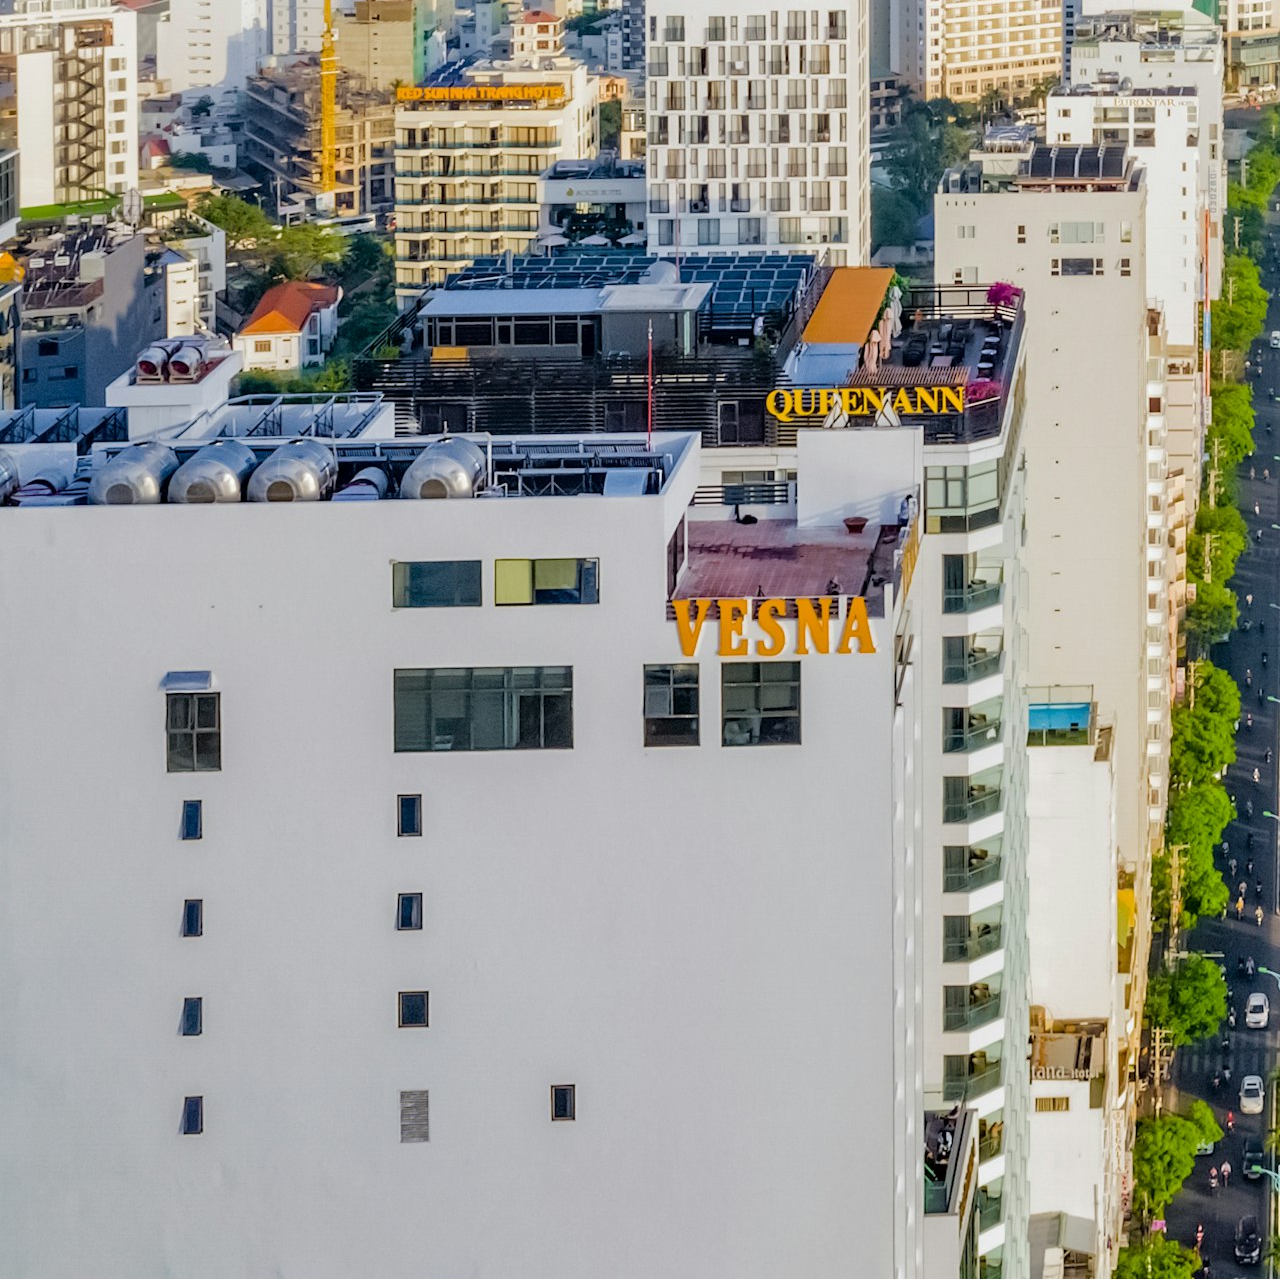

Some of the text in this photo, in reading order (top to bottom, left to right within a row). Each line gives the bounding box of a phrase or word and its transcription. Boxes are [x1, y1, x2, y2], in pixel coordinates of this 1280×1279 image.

[396, 86, 564, 100] RED SUN NHA TRANG HOTEL
[672, 596, 877, 657] VESNA
